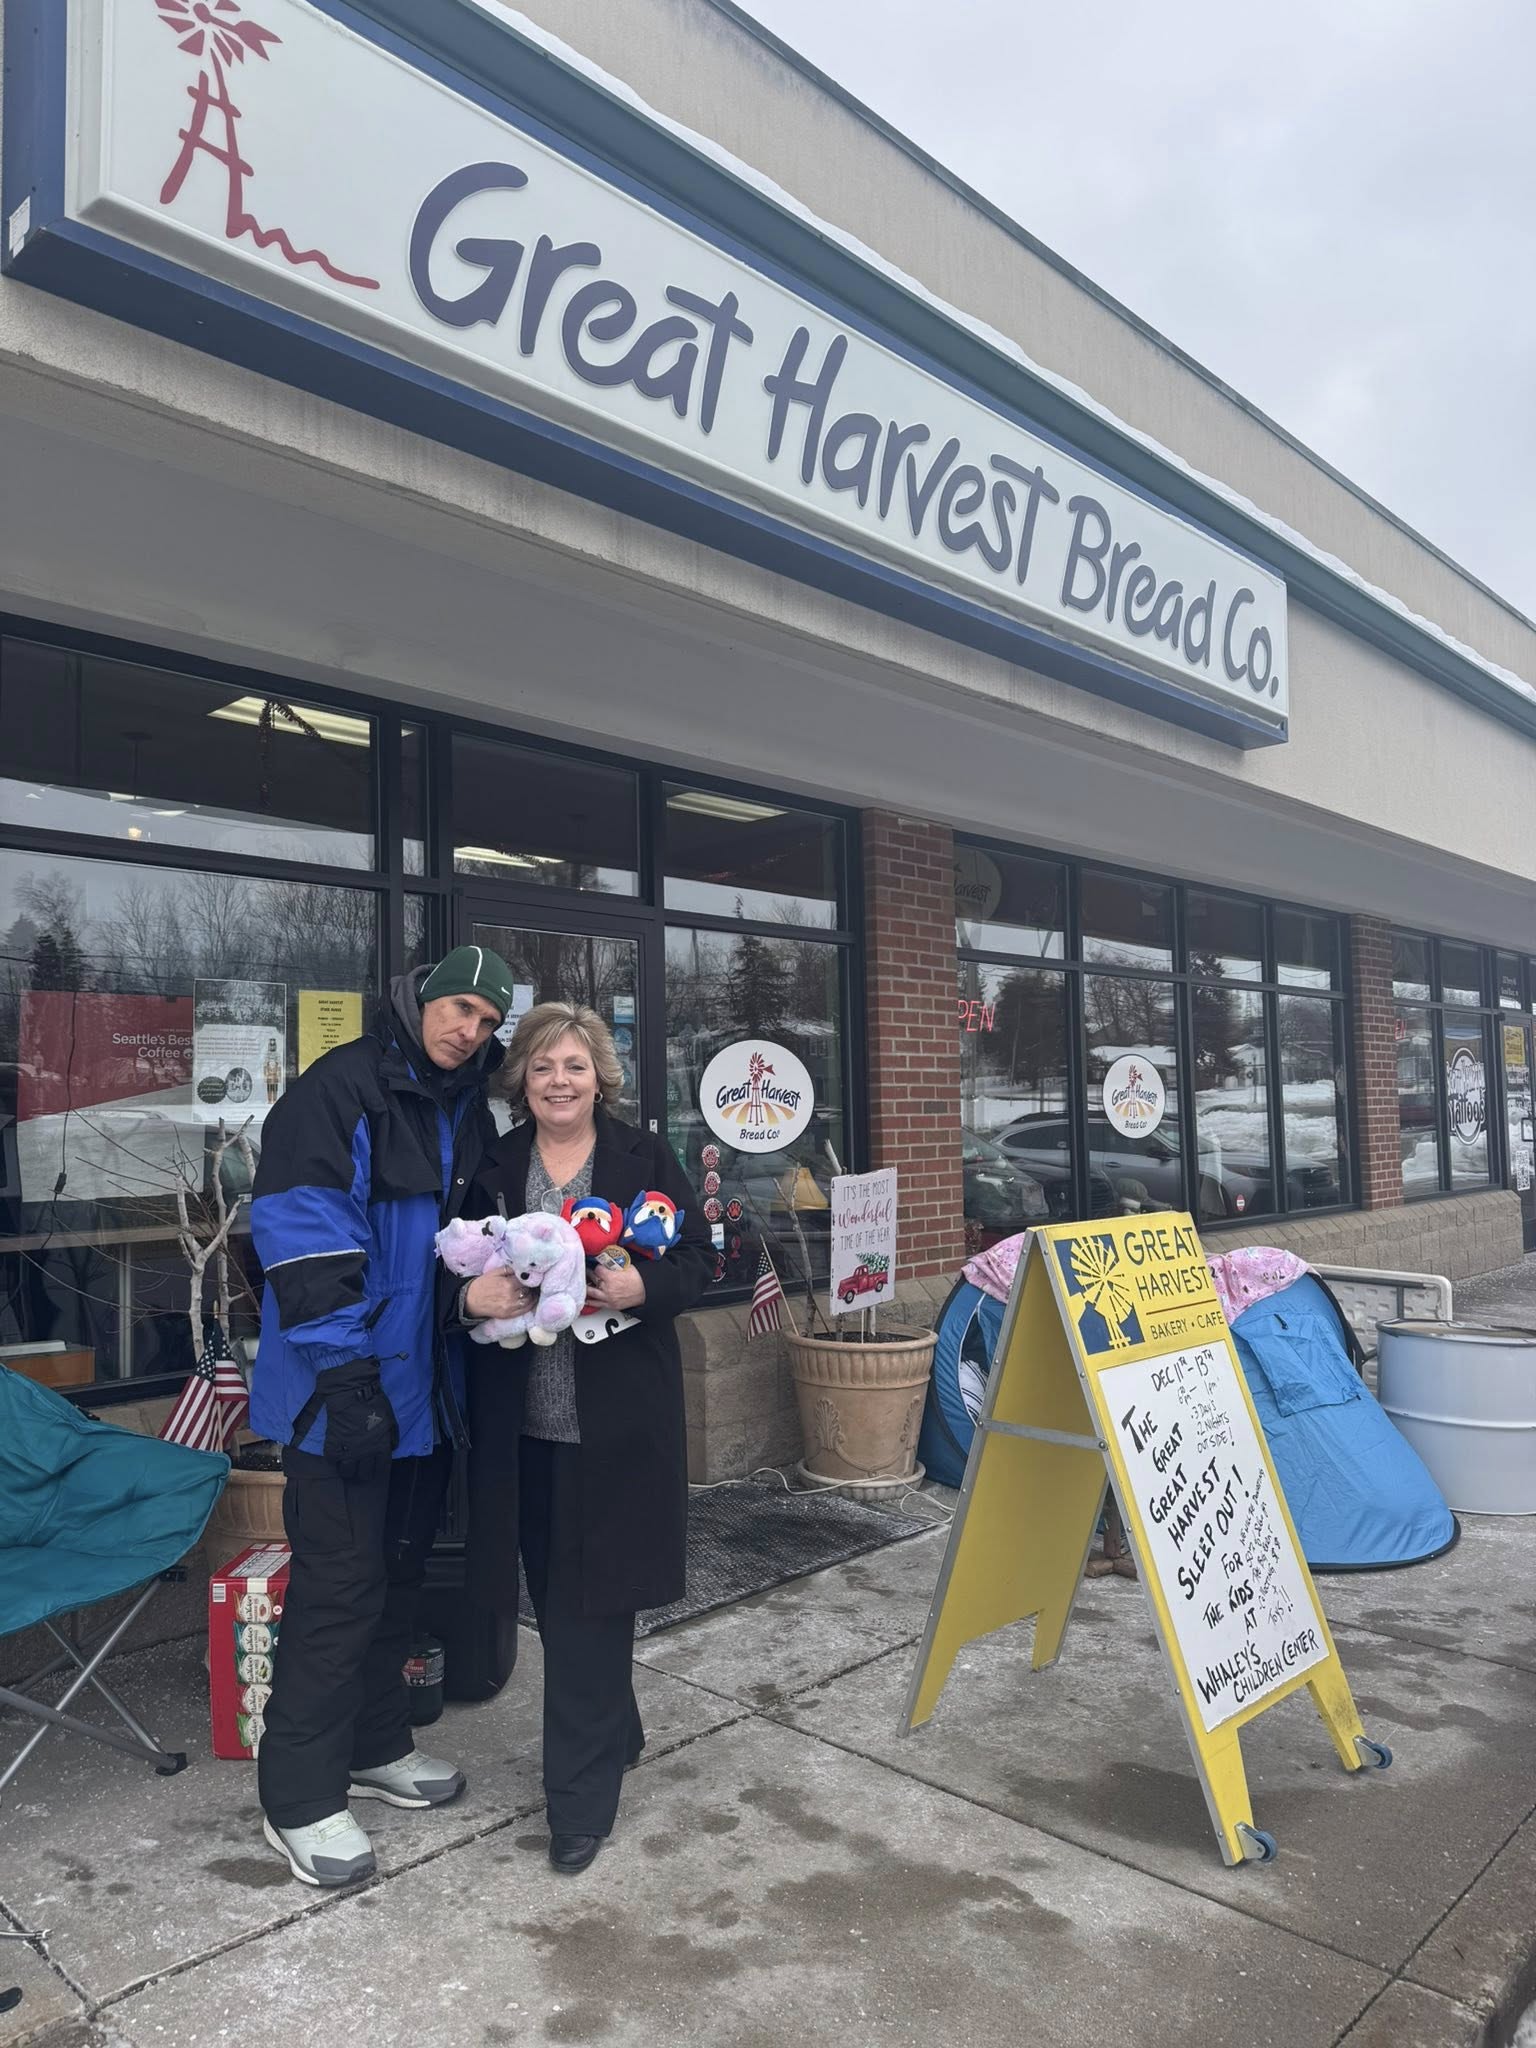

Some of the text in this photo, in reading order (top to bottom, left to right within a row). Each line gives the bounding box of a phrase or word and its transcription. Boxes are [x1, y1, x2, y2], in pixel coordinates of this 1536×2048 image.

[408, 160, 1279, 699] Great Harvest Bread Co.
[954, 879, 991, 903] arvest
[958, 1000, 996, 1032] PEN
[112, 1032, 165, 1046] Seattle's
[138, 1046, 181, 1059] Coffee
[716, 1079, 801, 1111] Great Harvest
[1112, 1084, 1158, 1107] Great Harvest
[1125, 1120, 1140, 1129] Bread
[1449, 1099, 1486, 1131] Tattoos
[740, 1128, 765, 1140] Bread
[843, 1179, 890, 1202] IT'S THE MOST
[838, 1198, 893, 1229] Wonderful
[840, 1226, 891, 1250] TIME OF THE YEAR
[1124, 1225, 1198, 1266] GREAT
[1135, 1266, 1210, 1302] HARVEST
[1150, 1310, 1225, 1340] BAKERY CAFE
[1151, 1366, 1175, 1392] DEC
[1121, 1405, 1158, 1454] THE
[1152, 1422, 1183, 1474] GREAT
[1150, 1462, 1188, 1524] GREAT
[1168, 1456, 1220, 1552] HARVEST
[1178, 1522, 1216, 1600] SLEEP
[1221, 1551, 1244, 1579] FOR
[1203, 1579, 1254, 1629] THE KIDS
[1244, 1607, 1258, 1635] AT
[1197, 1640, 1260, 1704] WHALEY'S
[1233, 1628, 1319, 1703] CHILDREN CENTER
